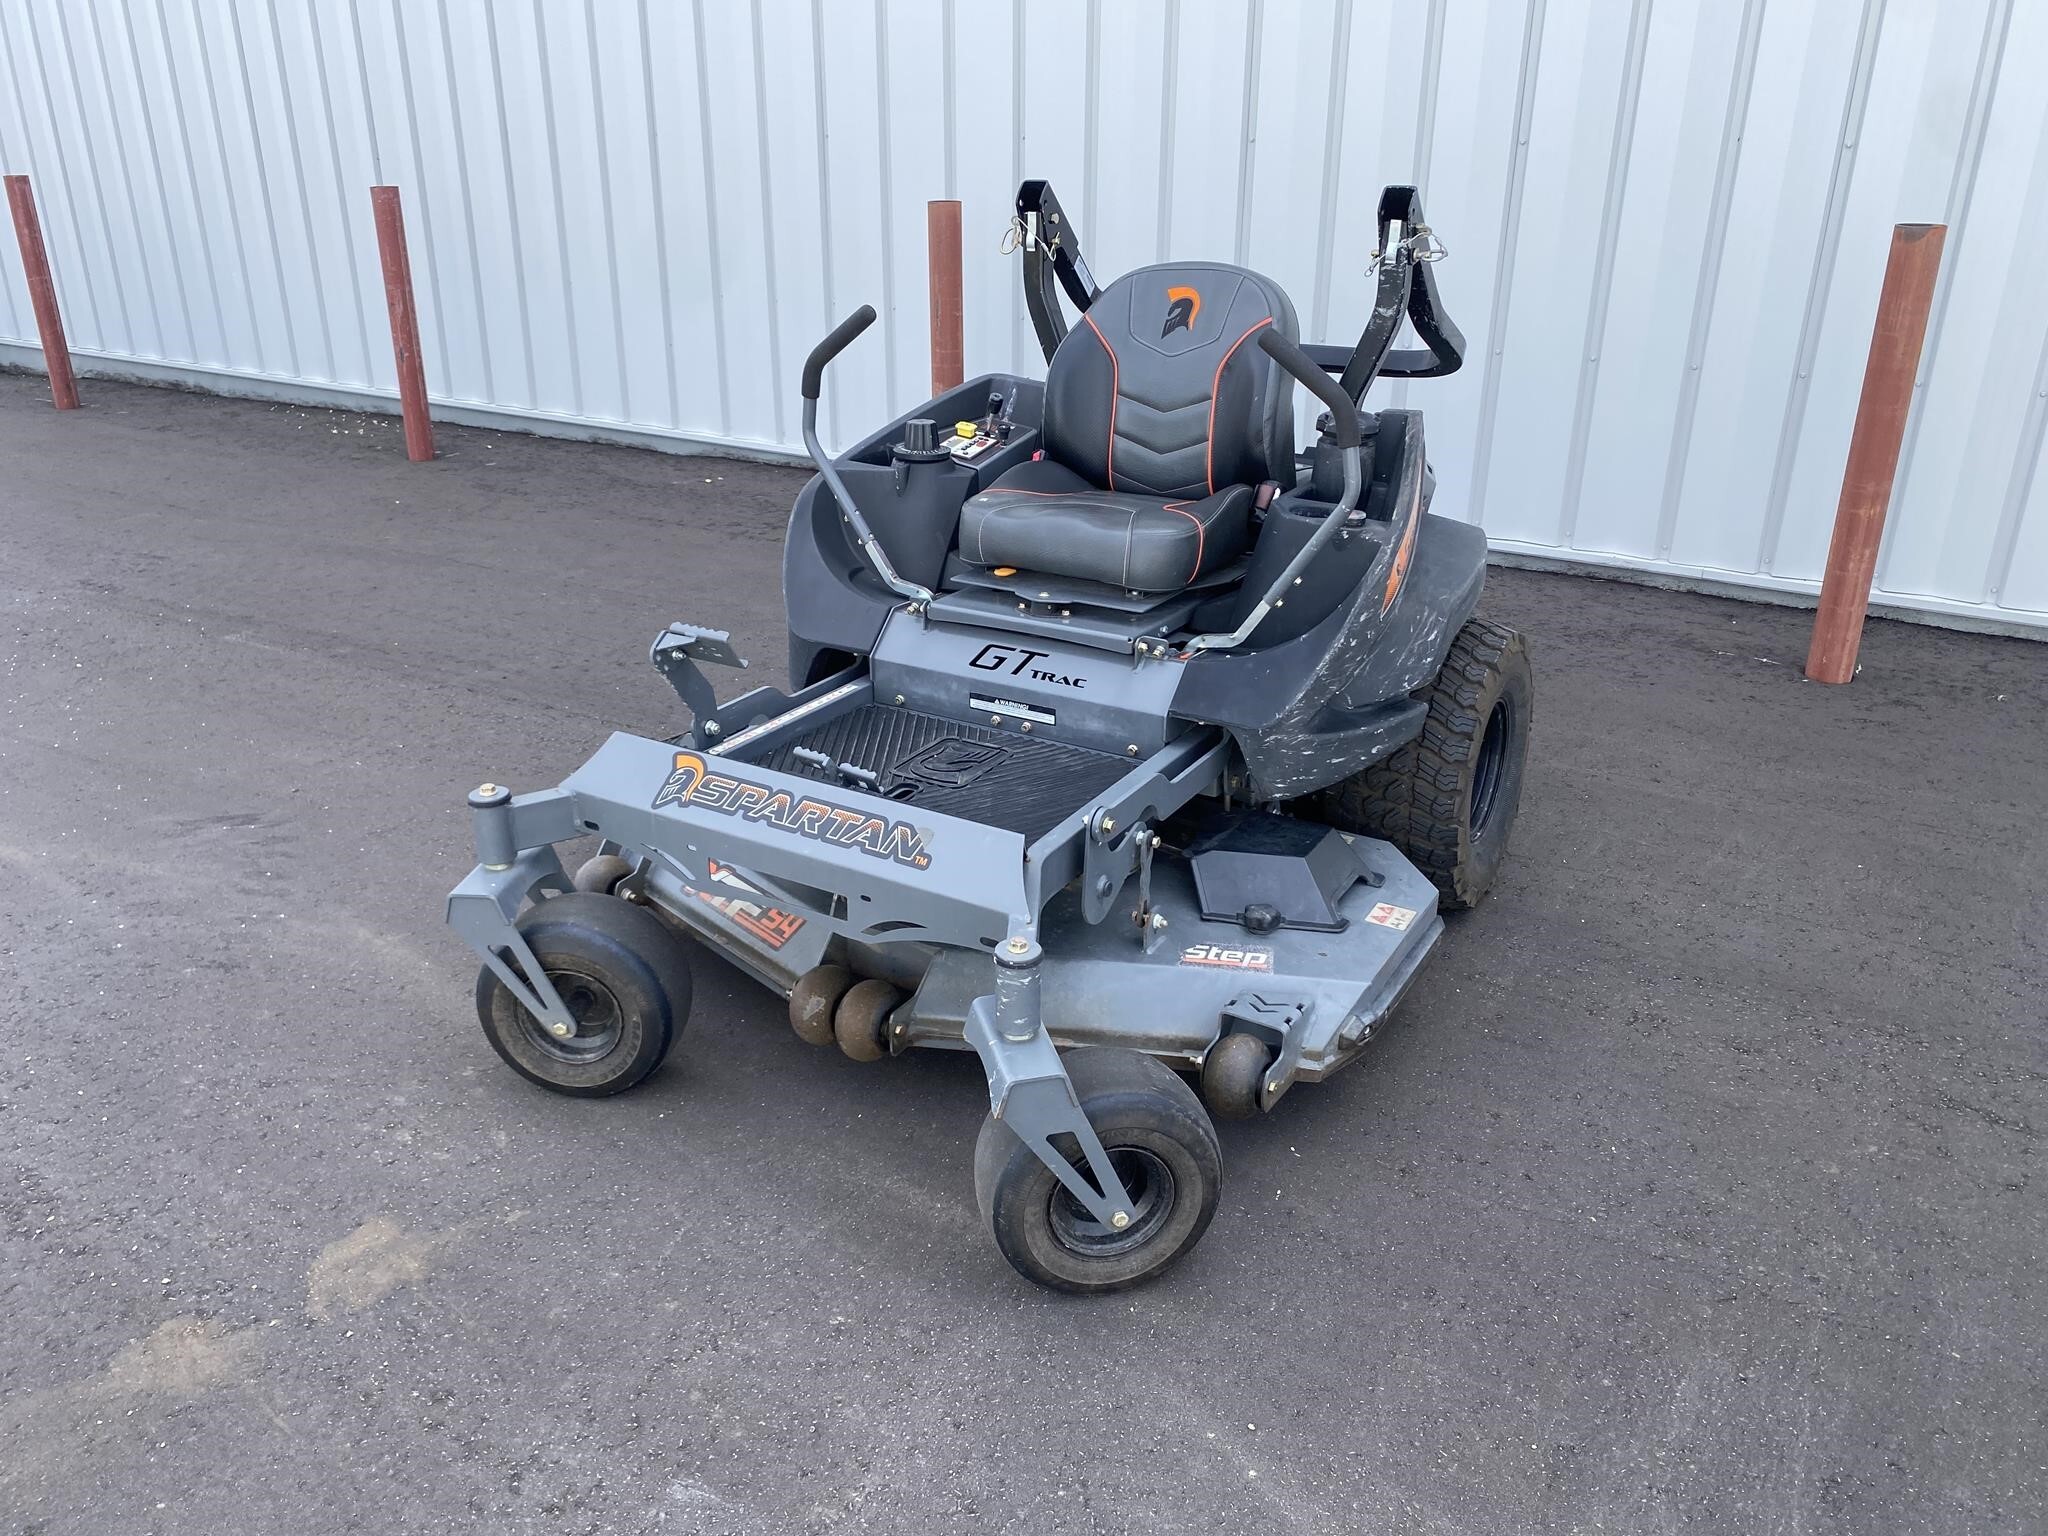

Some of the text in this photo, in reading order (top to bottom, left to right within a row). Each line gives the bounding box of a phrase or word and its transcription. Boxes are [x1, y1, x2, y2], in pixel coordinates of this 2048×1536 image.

[969, 643, 1087, 689] GT TRAC
[689, 775, 925, 861] SPARTAN
[1184, 944, 1268, 968] Step
